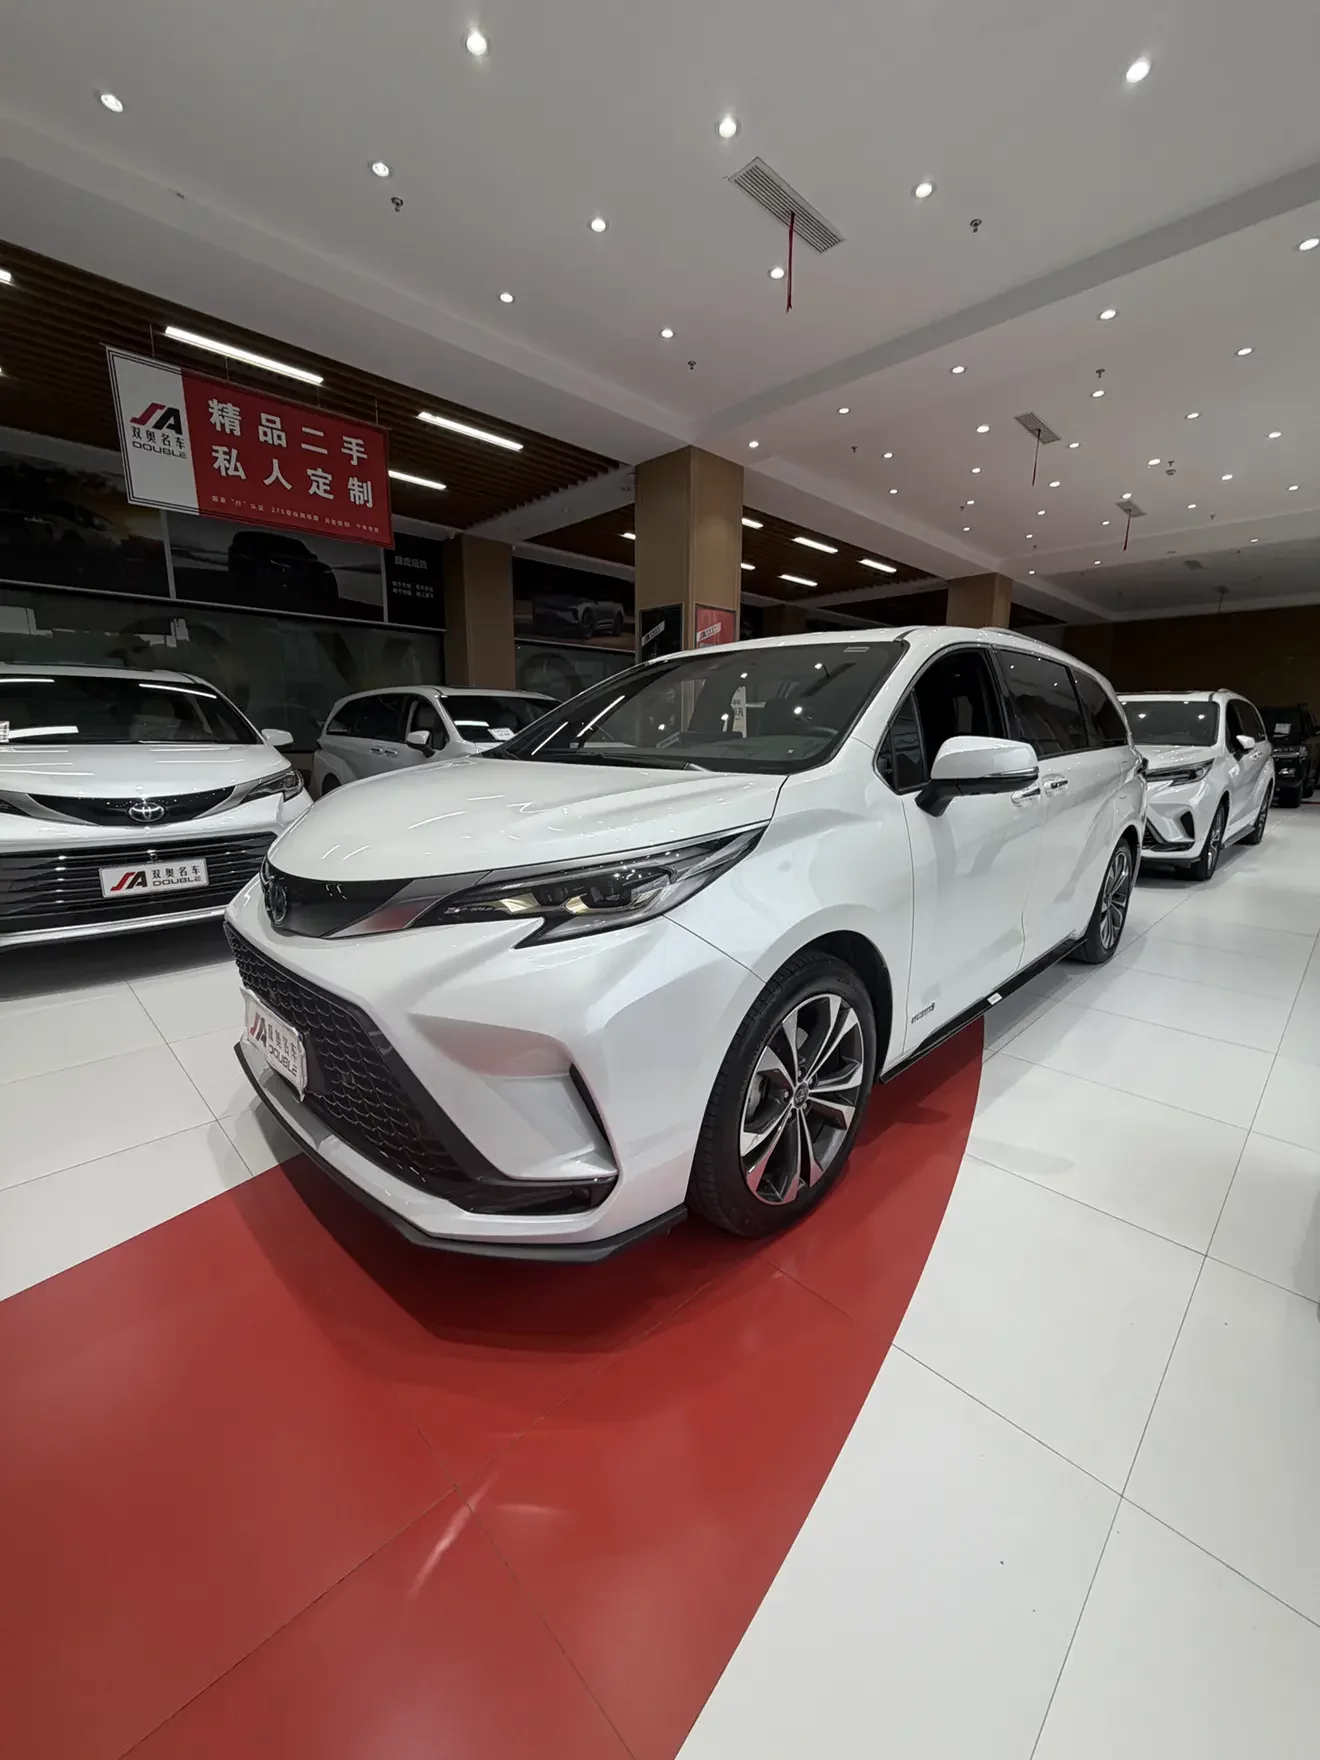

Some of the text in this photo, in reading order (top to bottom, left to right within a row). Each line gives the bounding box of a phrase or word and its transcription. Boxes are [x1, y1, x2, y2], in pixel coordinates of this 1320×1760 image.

[131, 425, 186, 450] 双奥名车
[208, 398, 368, 466] 精品二手
[132, 440, 187, 460] DOUBLE
[212, 444, 374, 508] 私人定制
[151, 865, 201, 880] 双奥名车
[152, 876, 202, 887] DOUBLE
